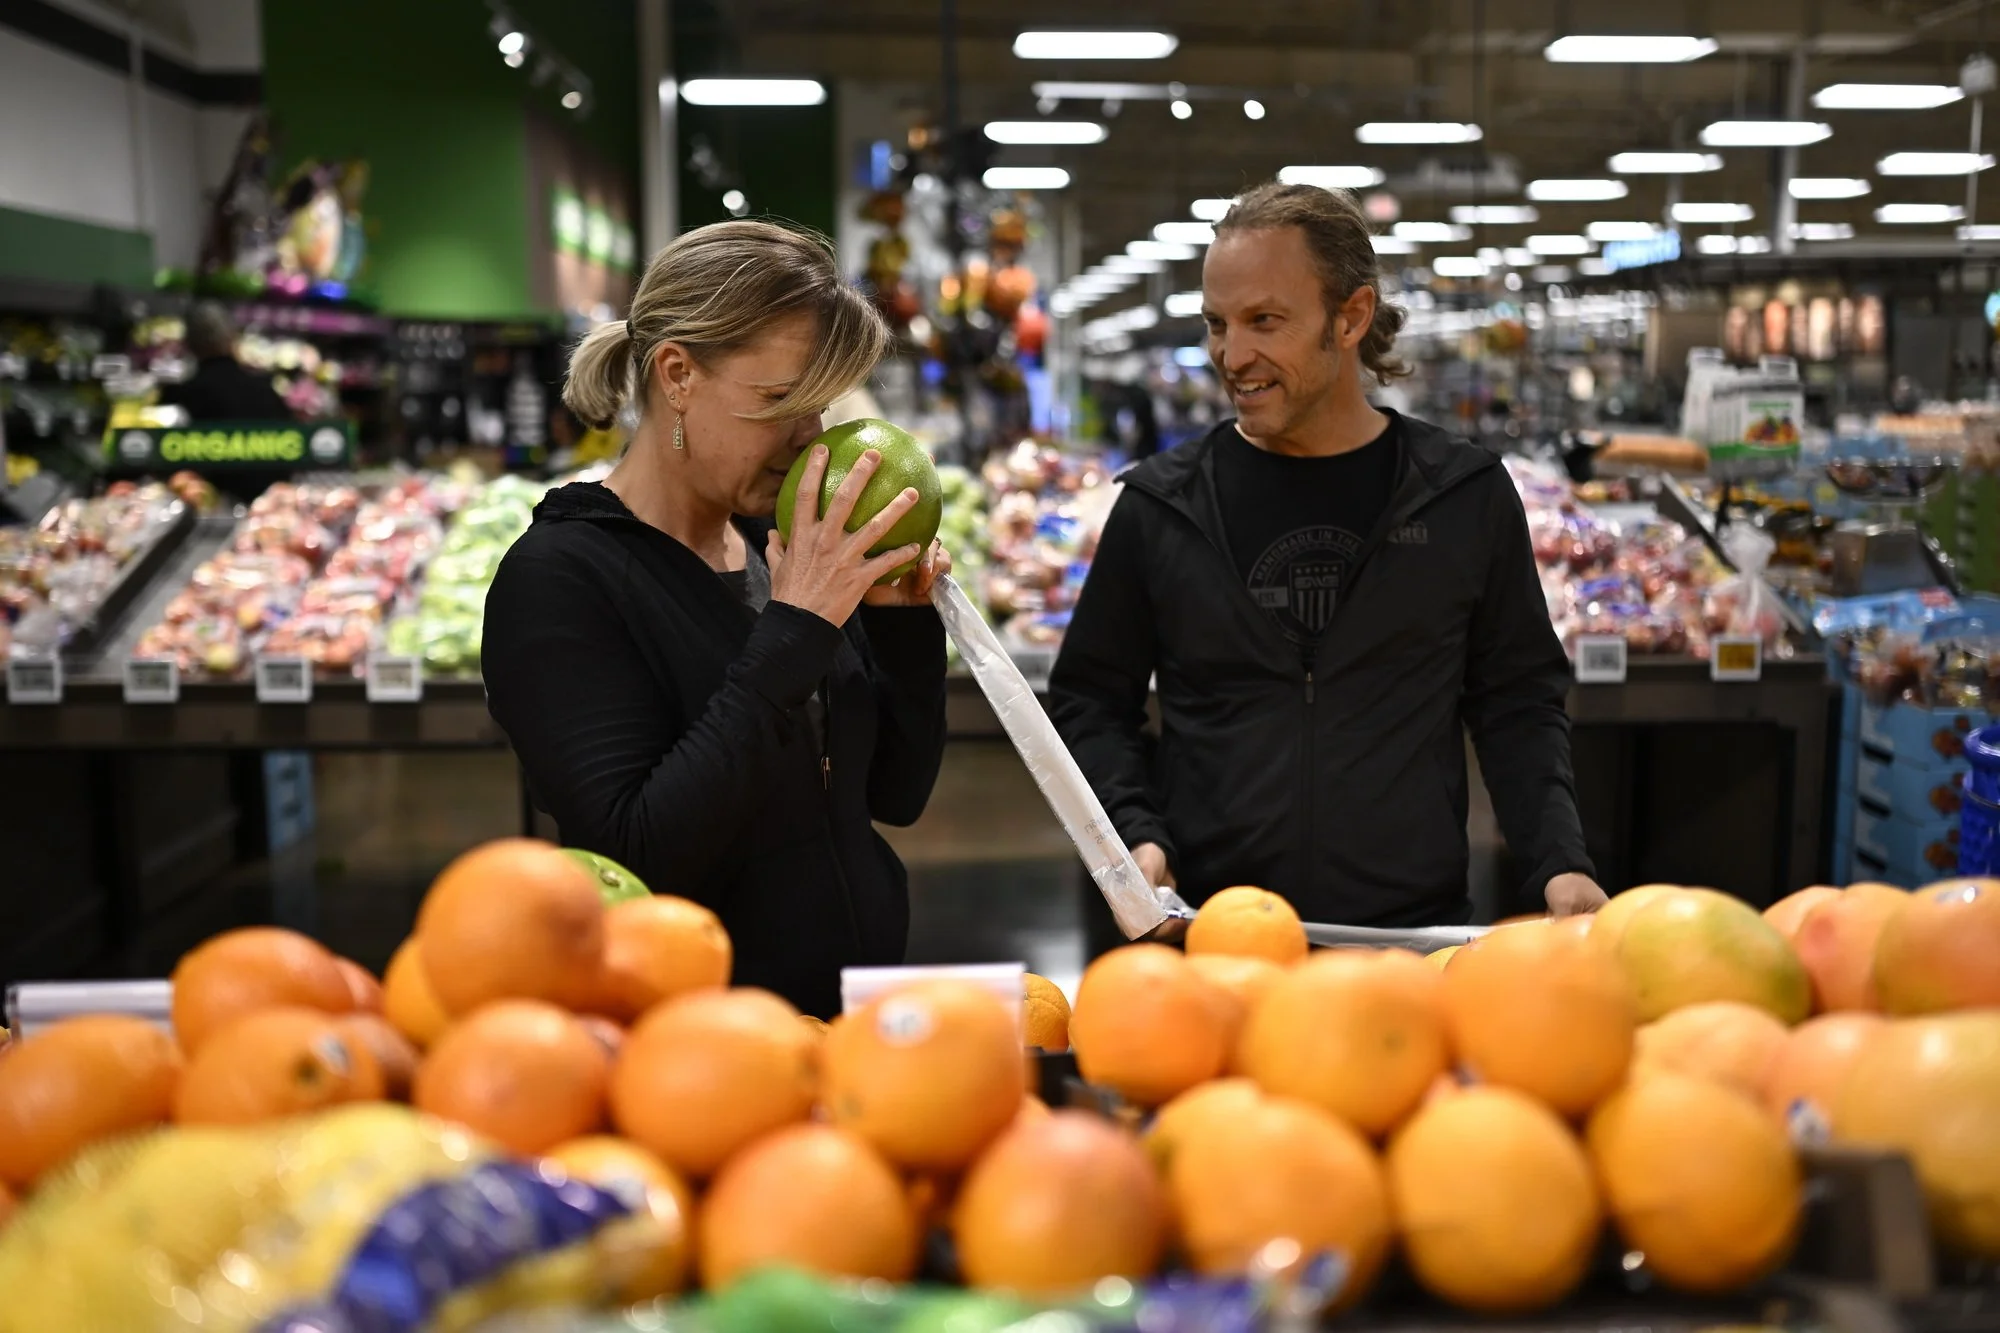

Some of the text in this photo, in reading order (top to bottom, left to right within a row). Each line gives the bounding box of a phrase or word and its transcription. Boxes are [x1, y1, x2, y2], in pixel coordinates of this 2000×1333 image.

[161, 430, 304, 461] ORGANIC
[1254, 532, 1315, 581] HANDMADE
[1318, 529, 1332, 541] IN
